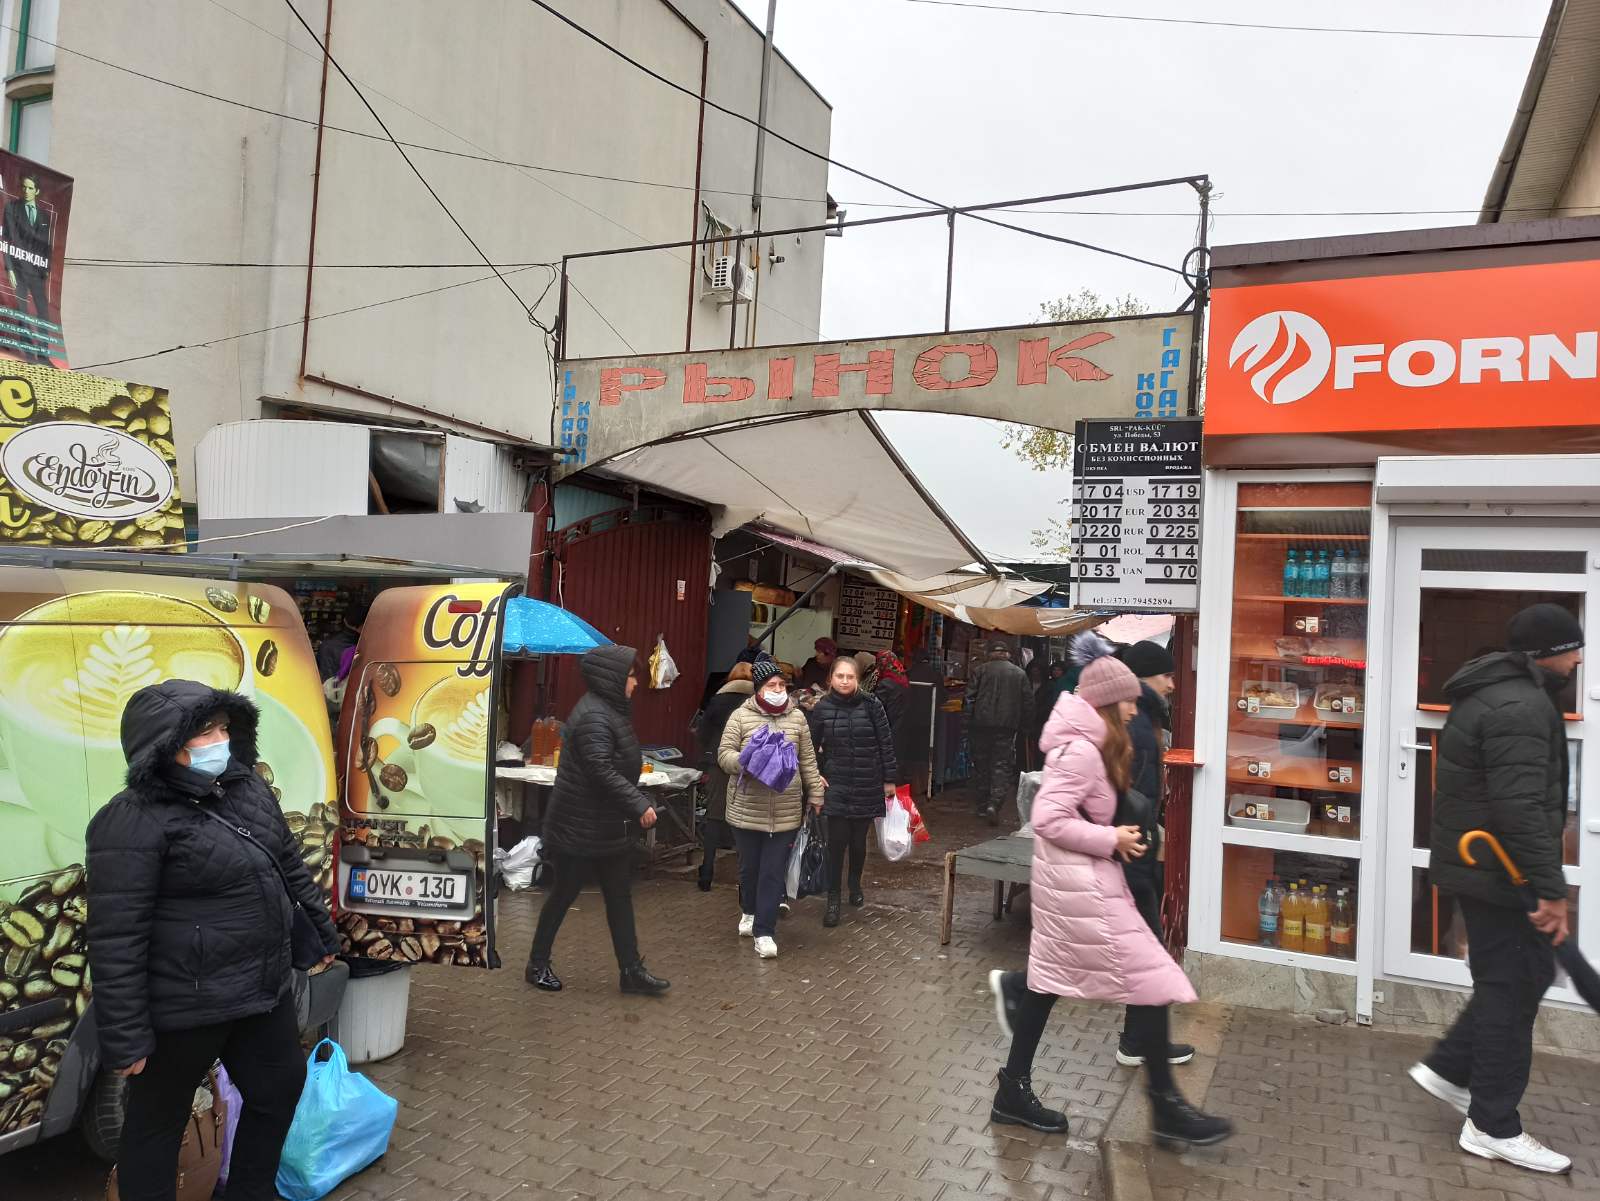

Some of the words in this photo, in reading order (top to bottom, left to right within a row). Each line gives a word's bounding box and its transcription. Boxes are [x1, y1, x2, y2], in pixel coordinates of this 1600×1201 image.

[9, 244, 49, 269] ОДЕЖДЫ
[1334, 331, 1598, 390] FORN
[598, 331, 1113, 406] РЫНОК
[1077, 442, 1134, 453] ОБМЕН
[1140, 441, 1199, 452] ВАЛЮТ
[1107, 454, 1184, 462] КОМИССИОННЫХ
[1126, 488, 1145, 496] USD
[1125, 508, 1145, 516] EUR
[1123, 548, 1144, 556] ROL
[1122, 567, 1143, 575] UAN
[353, 884, 364, 893] MD
[367, 873, 403, 896] OYK
[419, 876, 455, 900] 130
